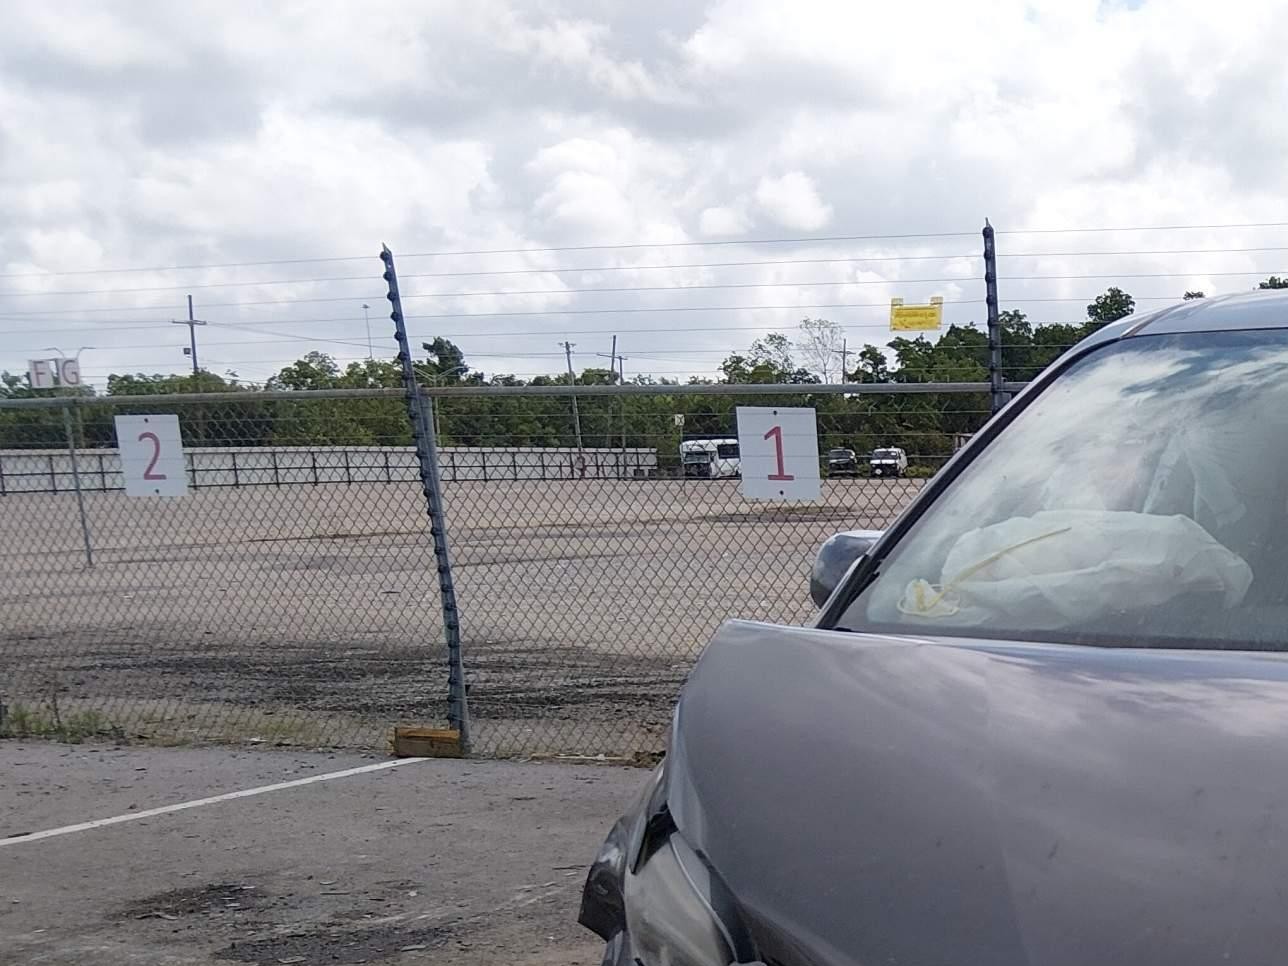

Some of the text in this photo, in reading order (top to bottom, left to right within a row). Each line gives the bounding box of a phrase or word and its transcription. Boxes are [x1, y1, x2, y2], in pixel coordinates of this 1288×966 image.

[33, 360, 46, 386] F
[61, 359, 80, 386] G
[138, 431, 167, 481] 2
[763, 426, 795, 481] 1
